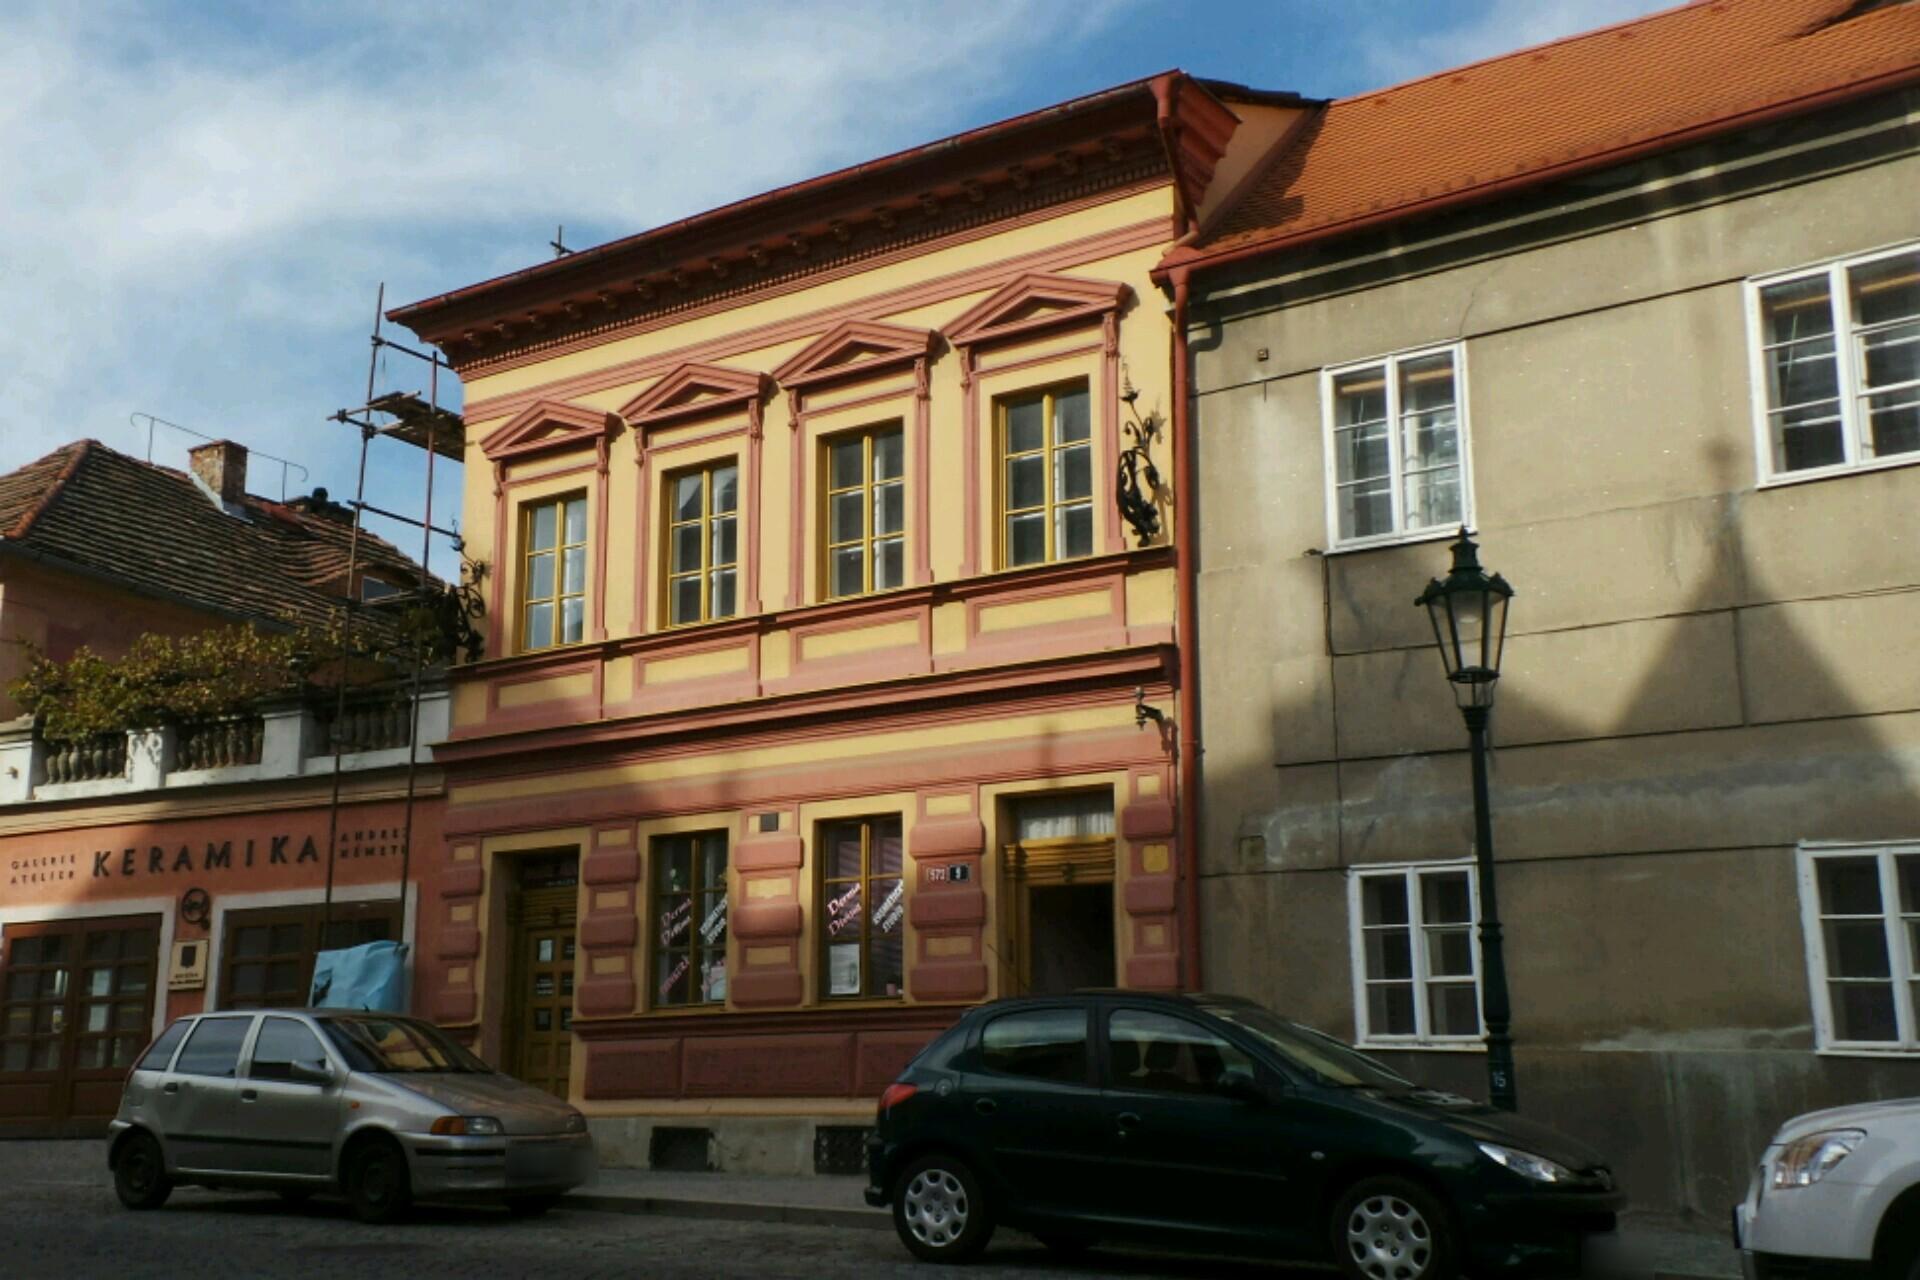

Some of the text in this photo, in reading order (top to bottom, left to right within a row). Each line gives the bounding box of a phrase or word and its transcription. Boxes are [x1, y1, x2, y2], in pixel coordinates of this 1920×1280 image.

[11, 854, 75, 870] GALERIE
[92, 835, 319, 878] KERAMIKA
[10, 870, 74, 885] ATELIER
